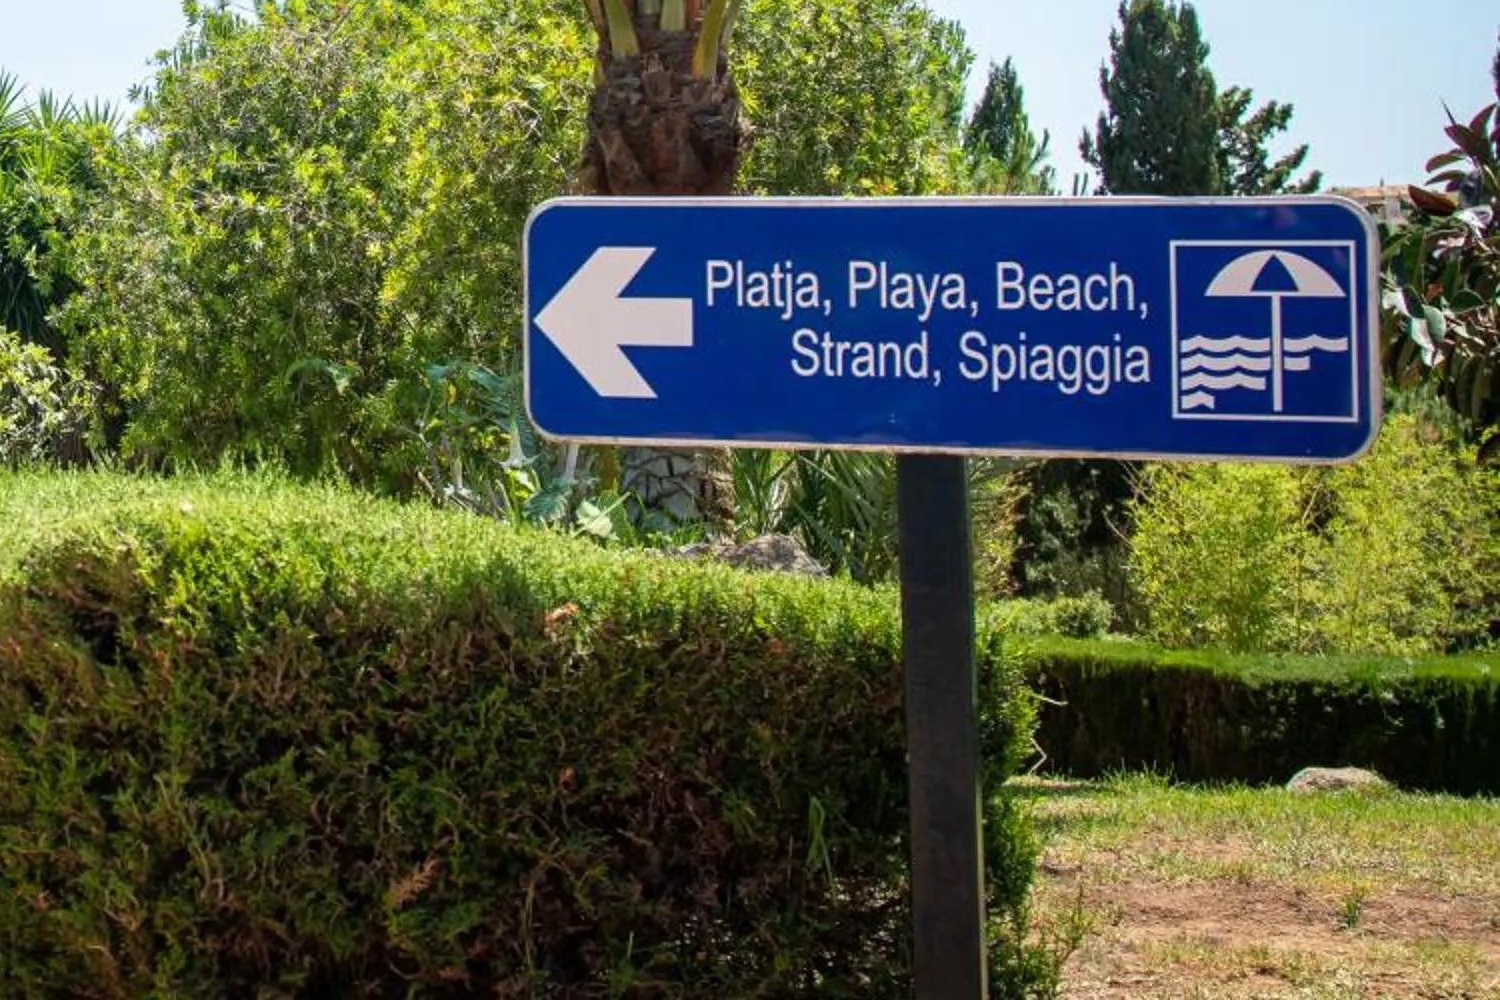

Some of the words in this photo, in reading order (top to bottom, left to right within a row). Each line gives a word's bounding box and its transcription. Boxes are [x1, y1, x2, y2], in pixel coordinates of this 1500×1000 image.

[706, 259, 832, 321] Platja,
[848, 260, 979, 323] Playa,
[996, 260, 1148, 320] Beach,
[790, 327, 942, 387] Strand,
[958, 330, 1151, 396] Spiaggia
